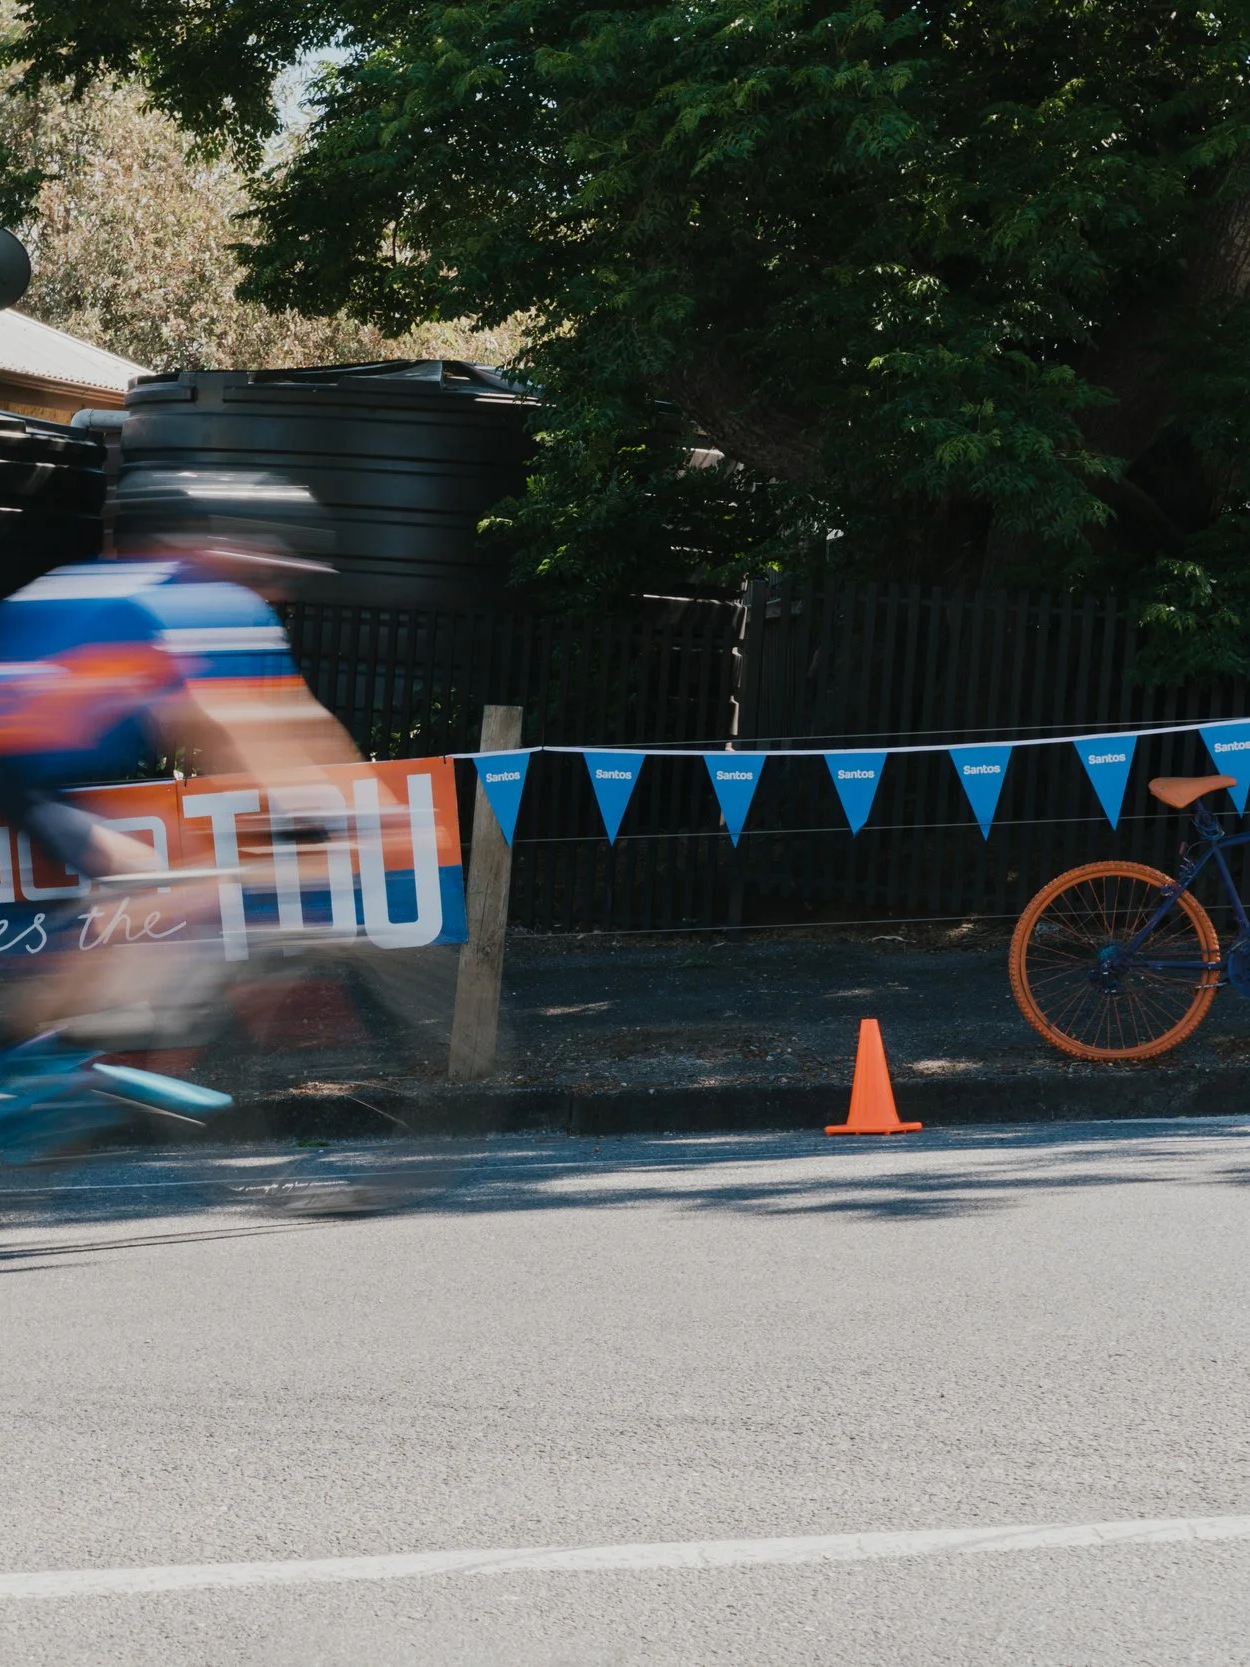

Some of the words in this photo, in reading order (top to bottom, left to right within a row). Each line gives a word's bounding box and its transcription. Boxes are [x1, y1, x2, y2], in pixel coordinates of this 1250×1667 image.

[1089, 753, 1127, 765] Santos
[596, 770, 631, 780] Santos
[838, 770, 875, 780] Santos
[964, 765, 1001, 775] Santos
[486, 771, 521, 783] Santos
[717, 771, 754, 781] Santos
[182, 773, 443, 961] TDU
[78, 897, 187, 951] the
